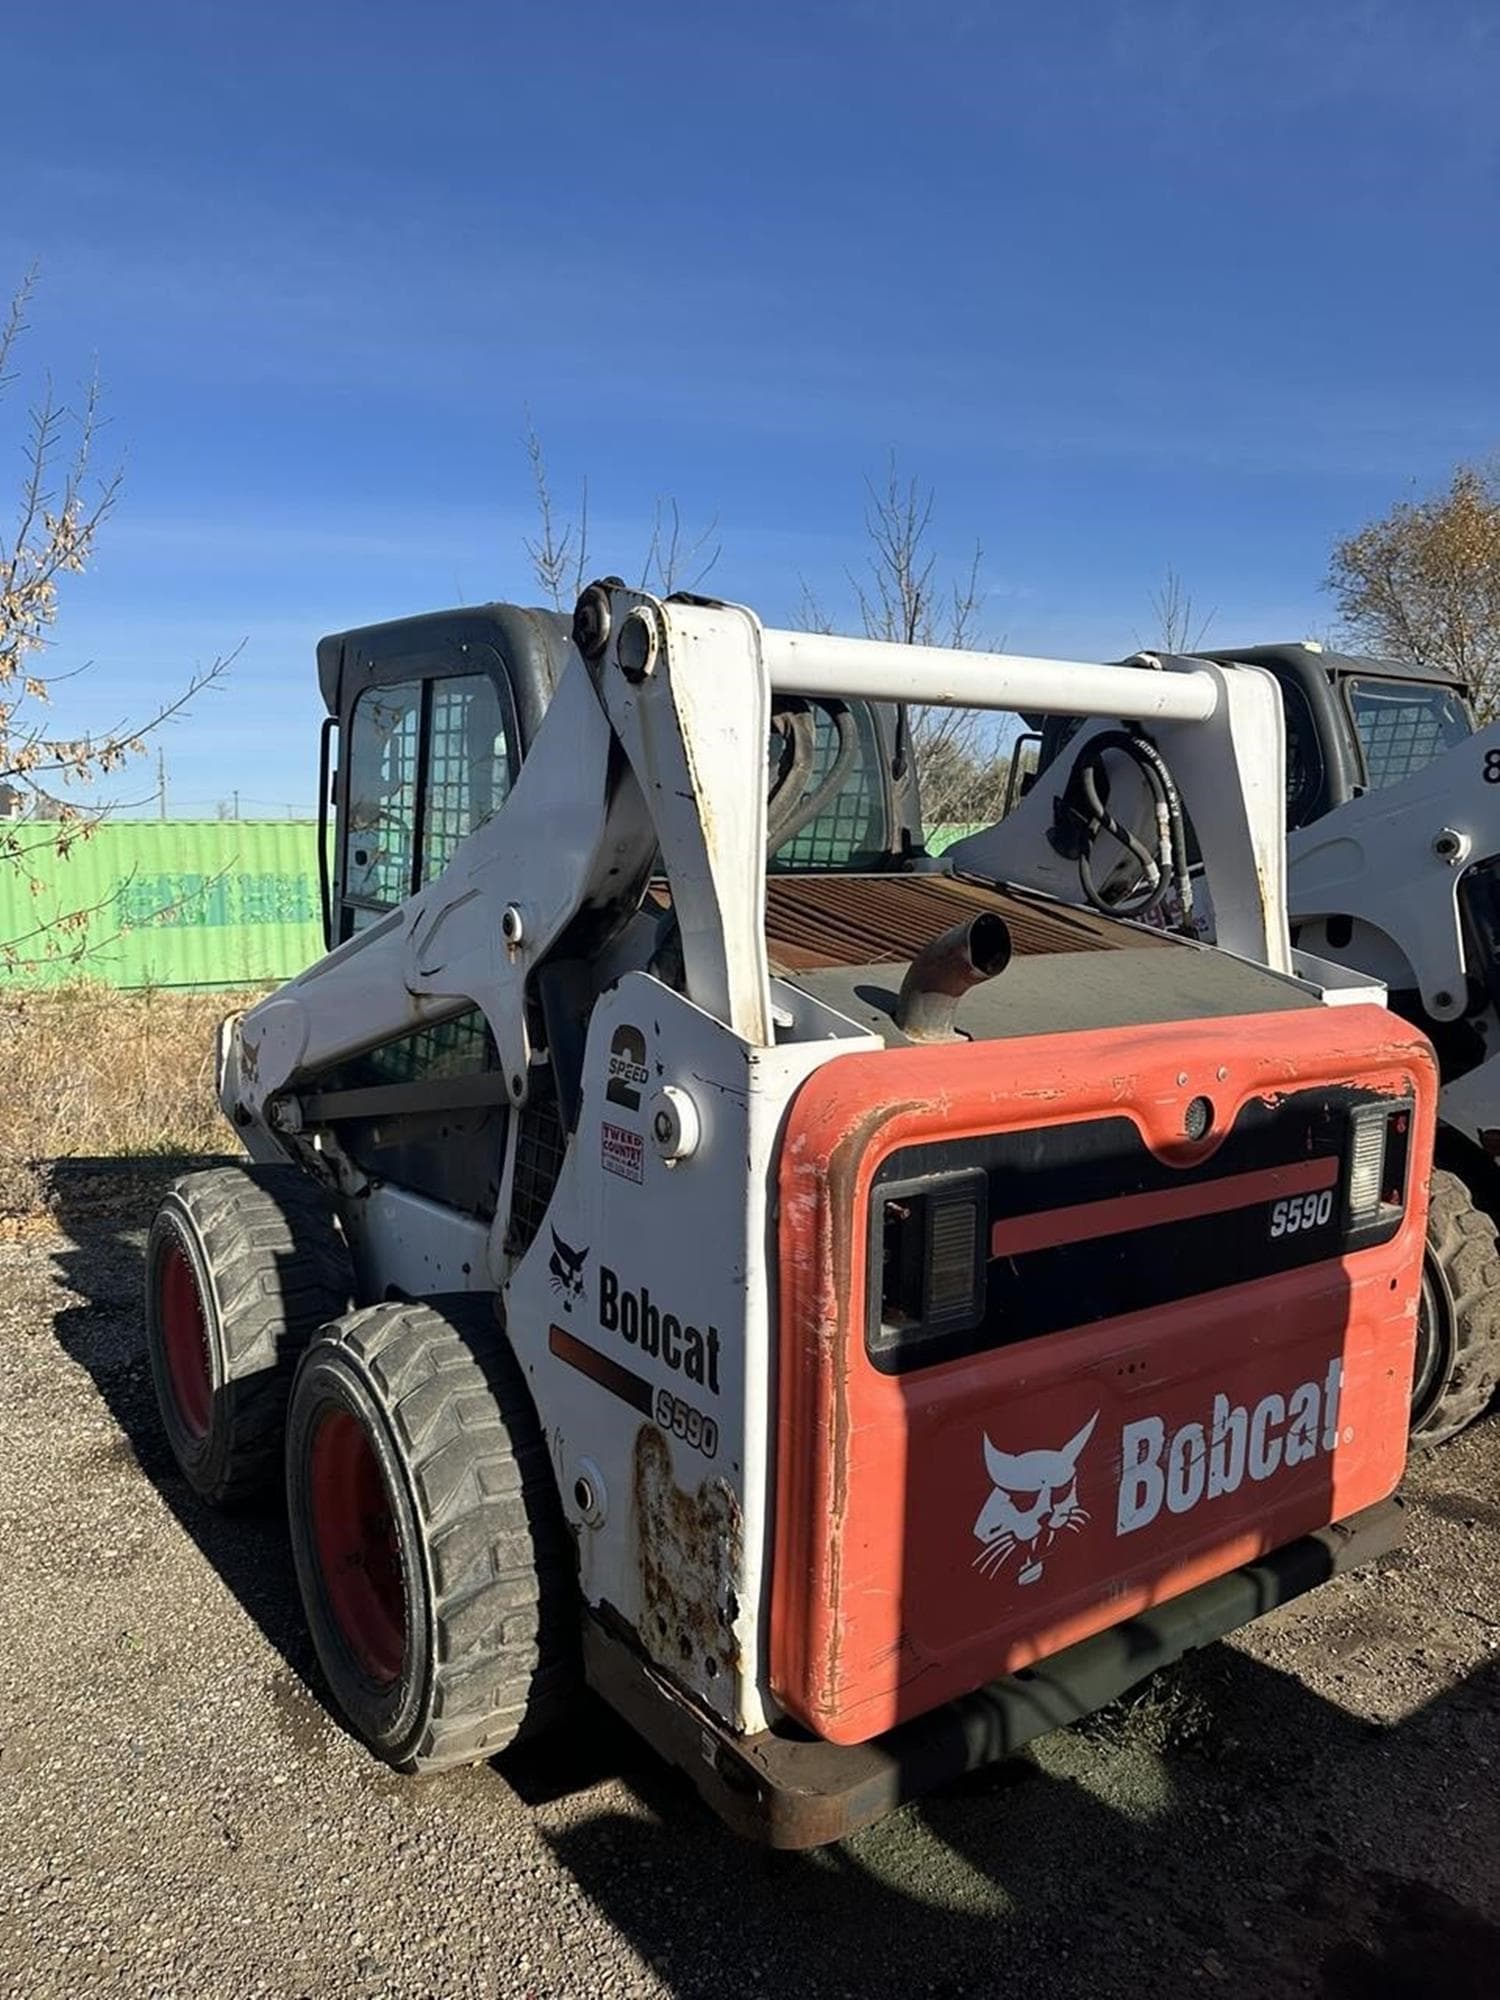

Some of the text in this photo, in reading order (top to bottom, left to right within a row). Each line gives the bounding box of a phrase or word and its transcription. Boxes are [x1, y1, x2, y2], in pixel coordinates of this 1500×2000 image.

[606, 1024, 646, 1112] 2
[609, 1057, 650, 1084] SPEED
[603, 1140, 641, 1162] COUNTRY
[604, 1126, 641, 1146] TWEED
[1269, 1190, 1333, 1238] S590
[599, 1265, 720, 1395] Bobcat
[655, 1389, 718, 1459] S590
[1116, 1356, 1345, 1537] Bobcat
